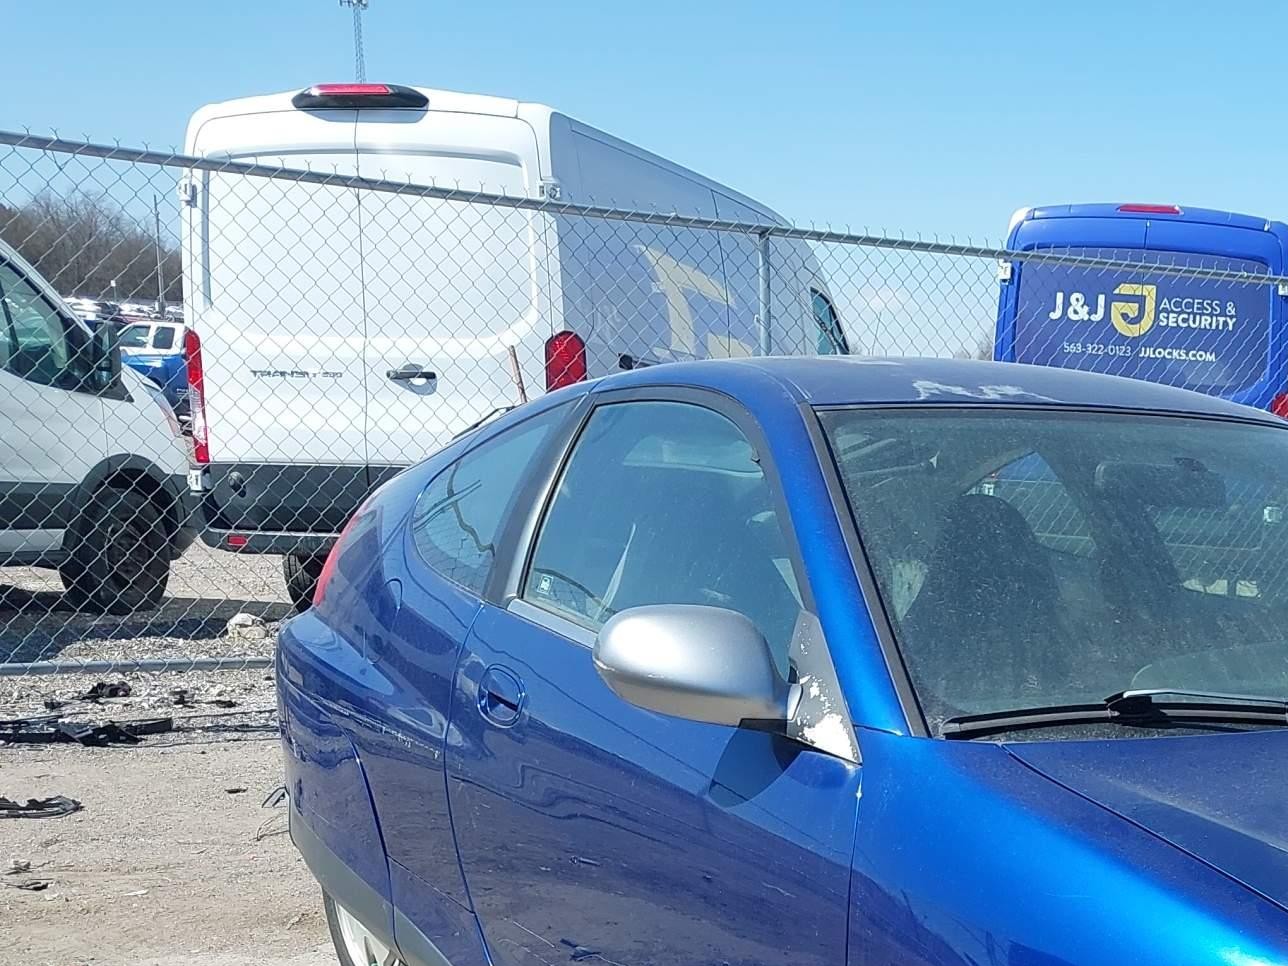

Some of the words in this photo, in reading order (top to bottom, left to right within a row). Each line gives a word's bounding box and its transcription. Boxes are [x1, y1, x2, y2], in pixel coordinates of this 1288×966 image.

[1048, 291, 1106, 322] J&J
[1159, 297, 1221, 315] ACCESS
[1225, 301, 1236, 316] &
[1158, 312, 1237, 331] SECURITY
[1063, 342, 1132, 357] 563-322-0123
[1138, 346, 1216, 362] JJLOCKS.COM
